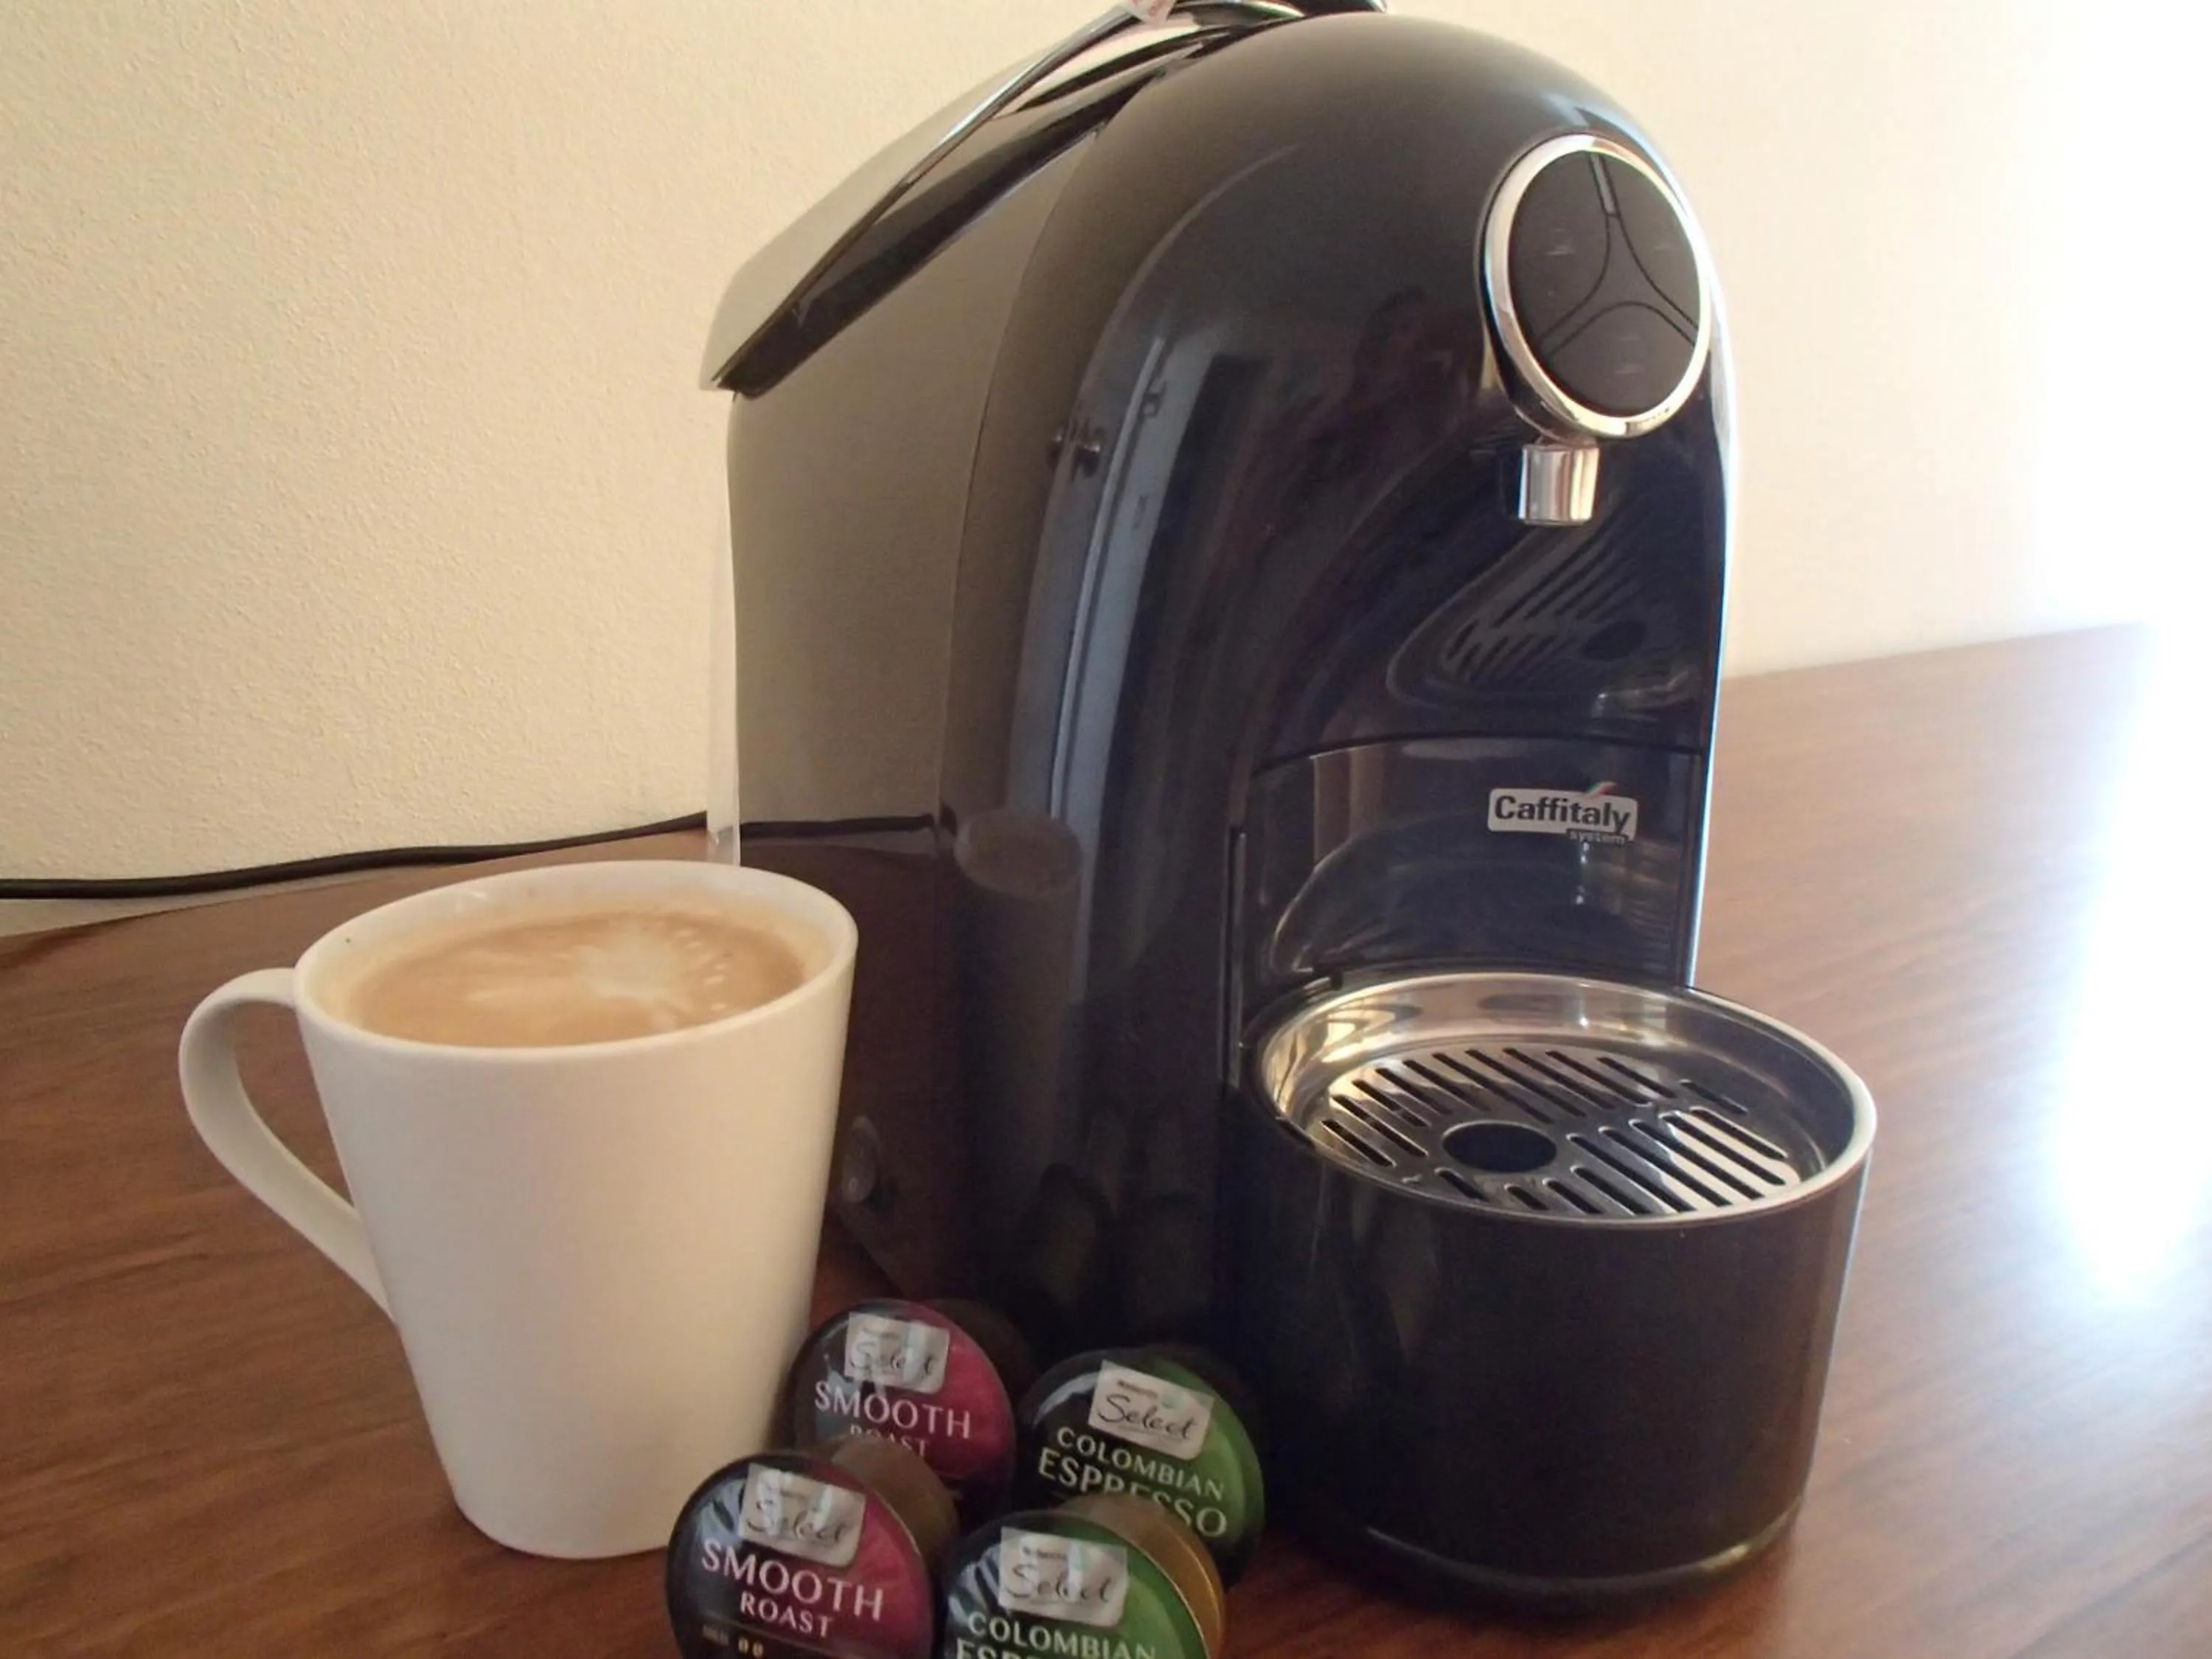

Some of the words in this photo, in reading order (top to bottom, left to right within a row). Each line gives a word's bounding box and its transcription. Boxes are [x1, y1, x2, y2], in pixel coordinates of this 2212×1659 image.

[1494, 795, 1632, 836] Caffitaly
[814, 1380, 970, 1439] SMOOTH
[1097, 1393, 1197, 1440] Select
[1057, 1426, 1224, 1500] COLOMBIAN
[701, 1537, 884, 1621] SMOOTH
[740, 1590, 835, 1638] ROAST
[967, 1611, 1155, 1659] COLOMBIAN
